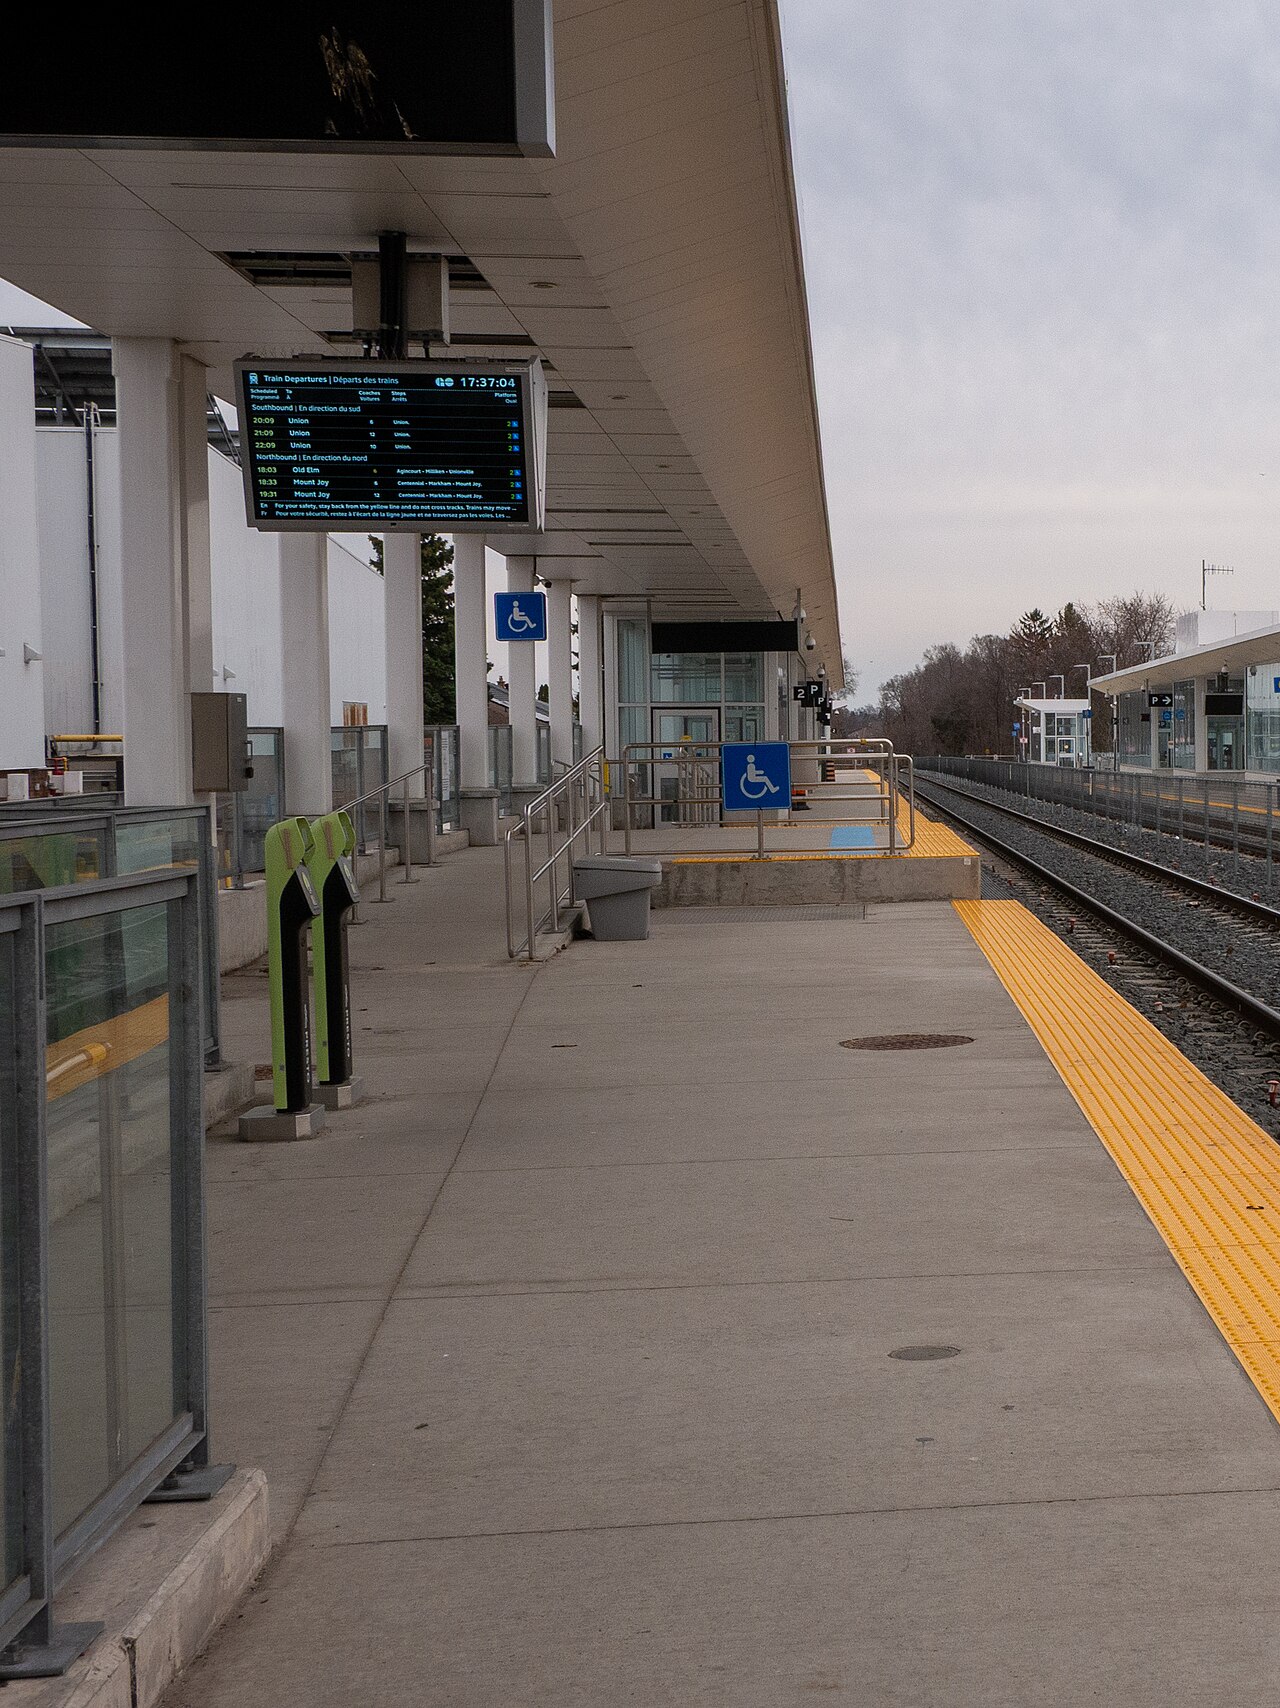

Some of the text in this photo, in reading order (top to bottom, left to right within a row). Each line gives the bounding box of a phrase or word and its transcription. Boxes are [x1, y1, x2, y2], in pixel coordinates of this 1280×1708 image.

[284, 376, 328, 384] Departures
[333, 376, 362, 384] Départs
[460, 378, 516, 388] 17:37:04
[317, 479, 330, 487] Joy
[797, 688, 805, 698] 2
[810, 684, 818, 694] P
[1152, 696, 1158, 704] P
